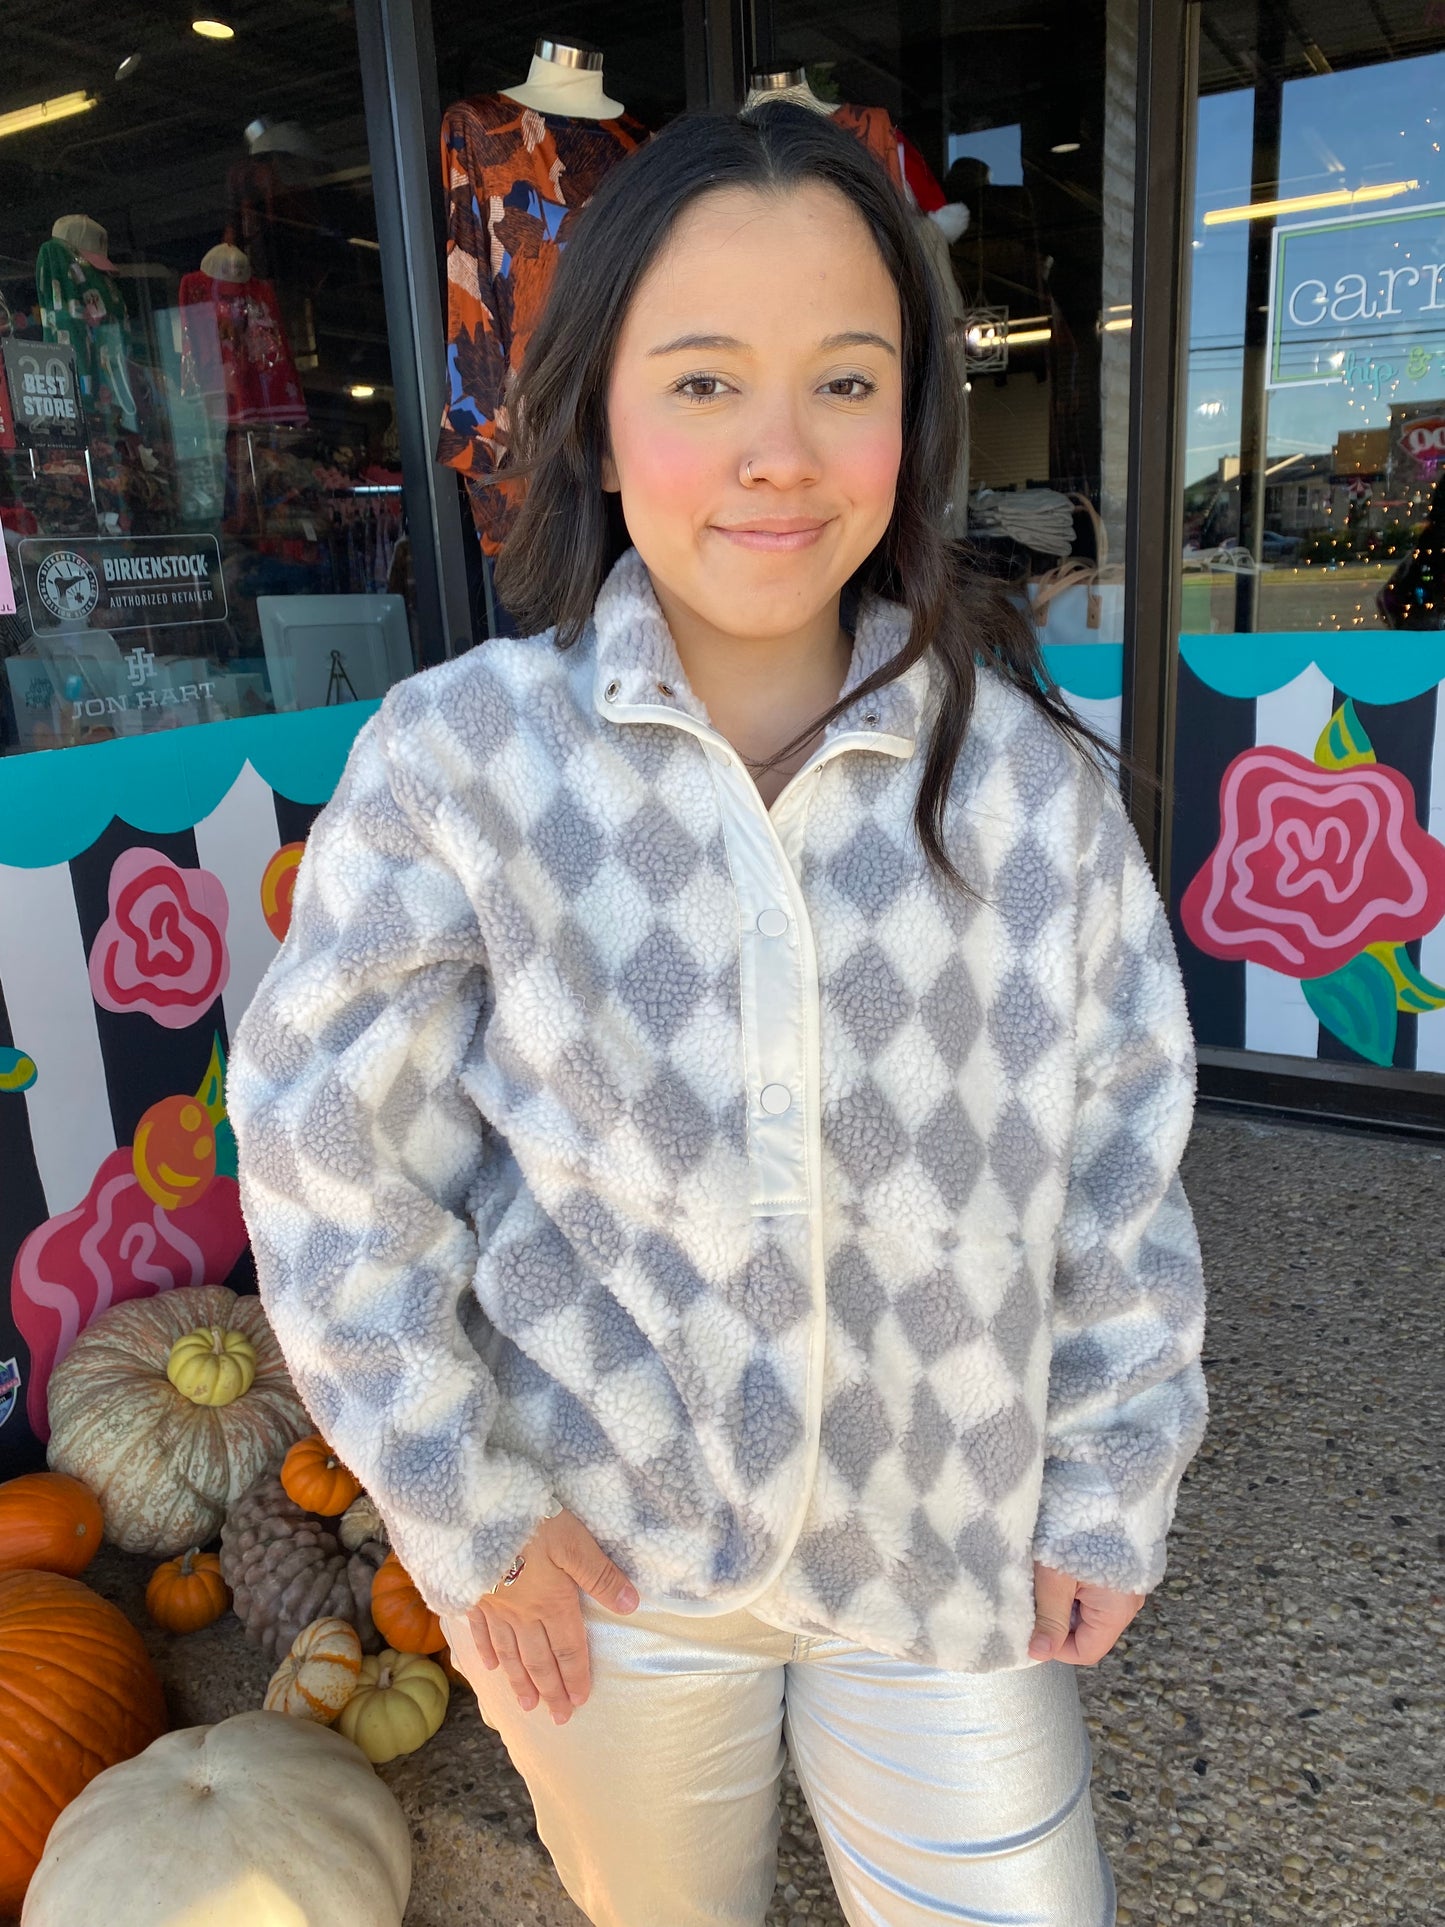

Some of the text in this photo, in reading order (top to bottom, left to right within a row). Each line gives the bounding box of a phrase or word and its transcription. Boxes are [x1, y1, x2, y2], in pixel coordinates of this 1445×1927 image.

[1345, 350, 1399, 400] hip
[1406, 345, 1433, 380] &
[24, 373, 66, 396] BEST
[23, 396, 76, 419] STORE
[41, 553, 91, 575] BIRKENSTOCK
[103, 554, 208, 582] BIRKENSTOCK
[110, 590, 214, 608] AUTHORIZED RETAILER
[71, 682, 215, 720] JON HART
